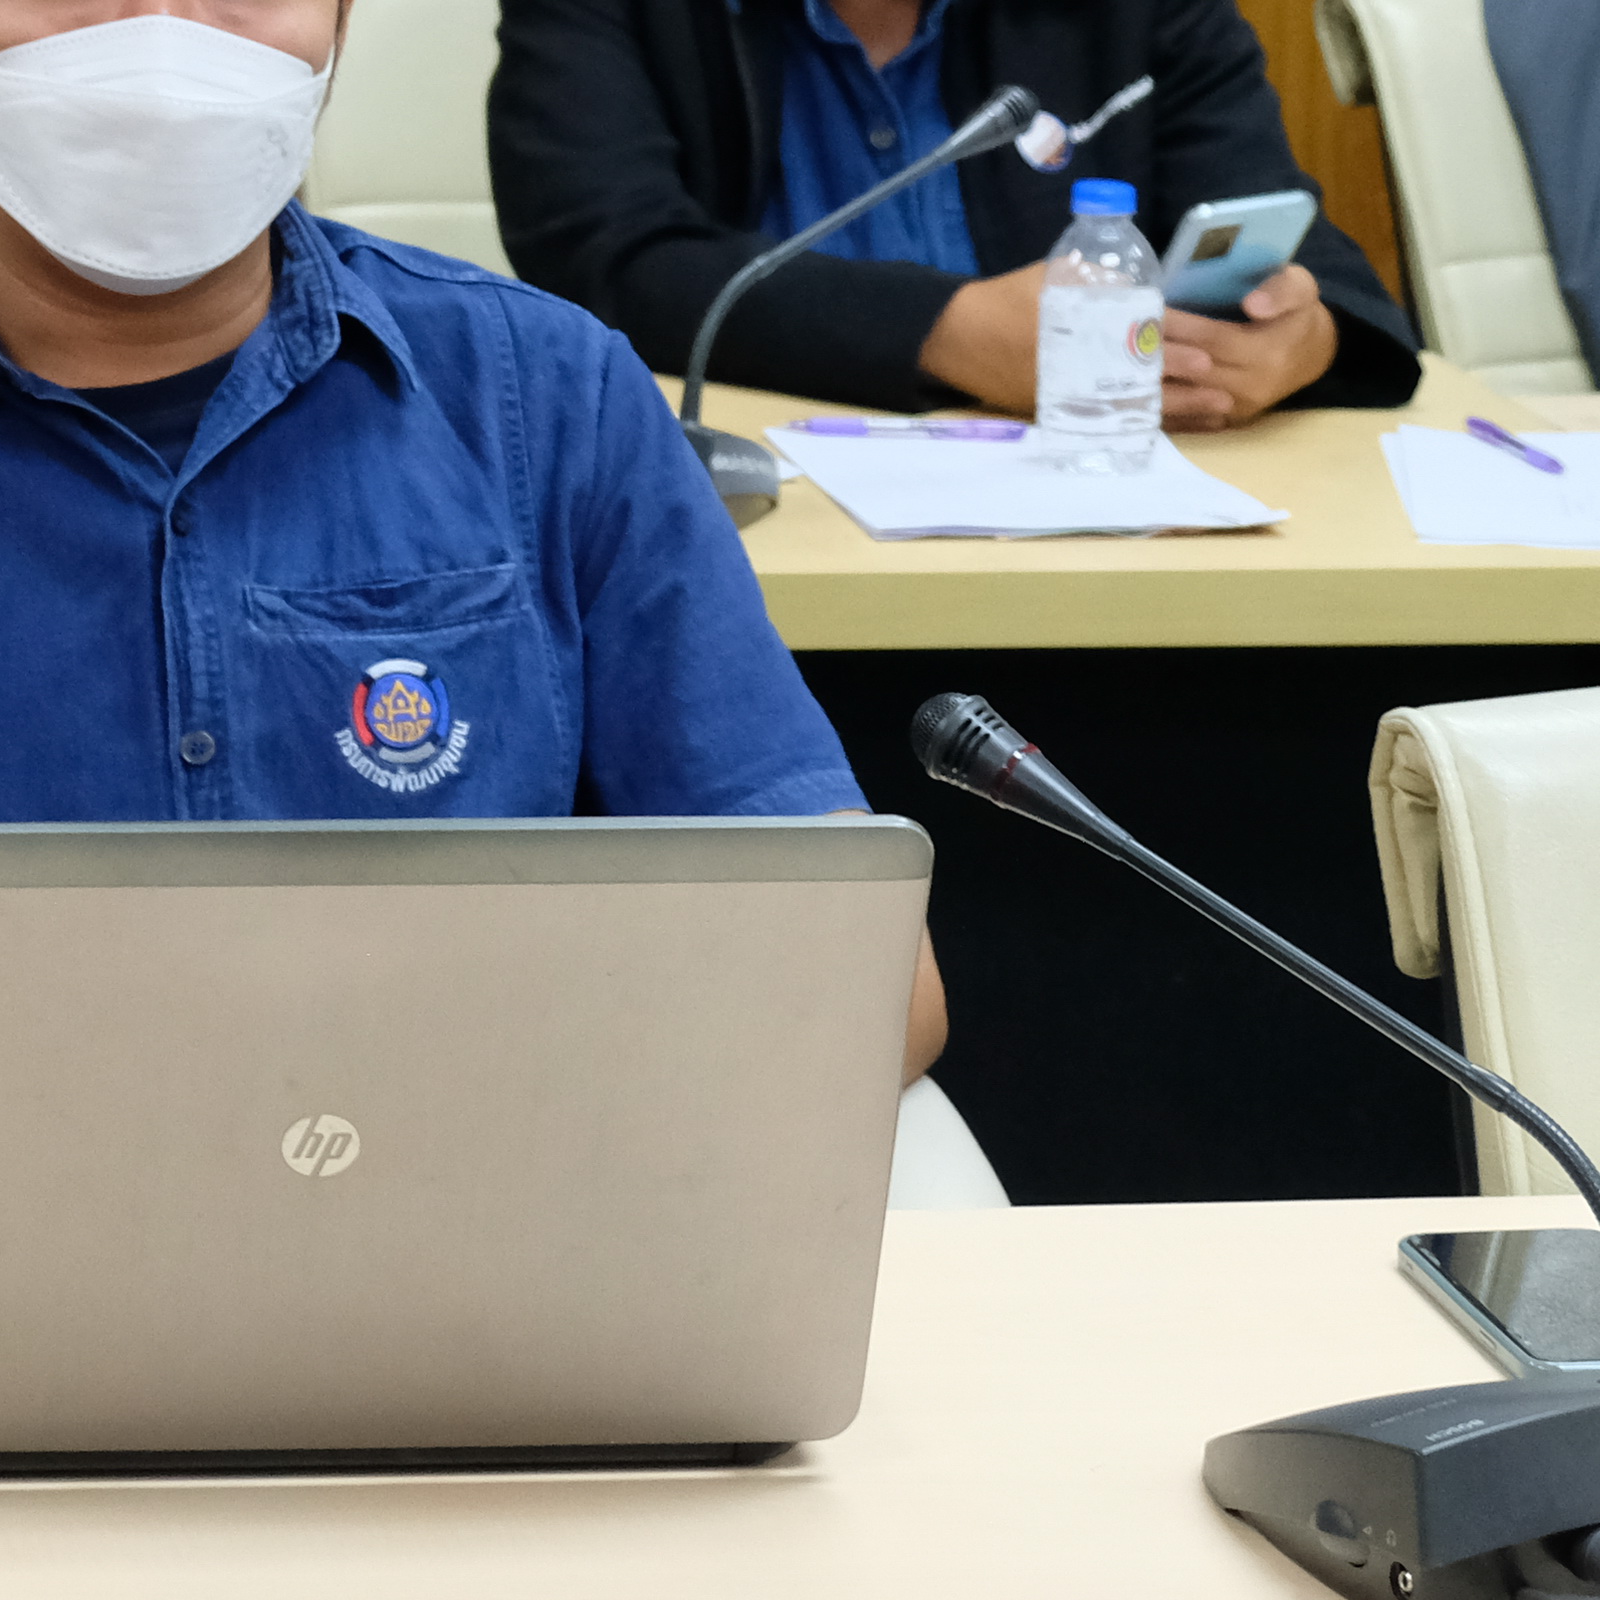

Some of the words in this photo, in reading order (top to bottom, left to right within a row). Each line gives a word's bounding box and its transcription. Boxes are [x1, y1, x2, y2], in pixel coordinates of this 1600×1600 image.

[334, 718, 472, 793] กรมการพัฒนาชุมชน
[287, 1114, 357, 1177] hp
